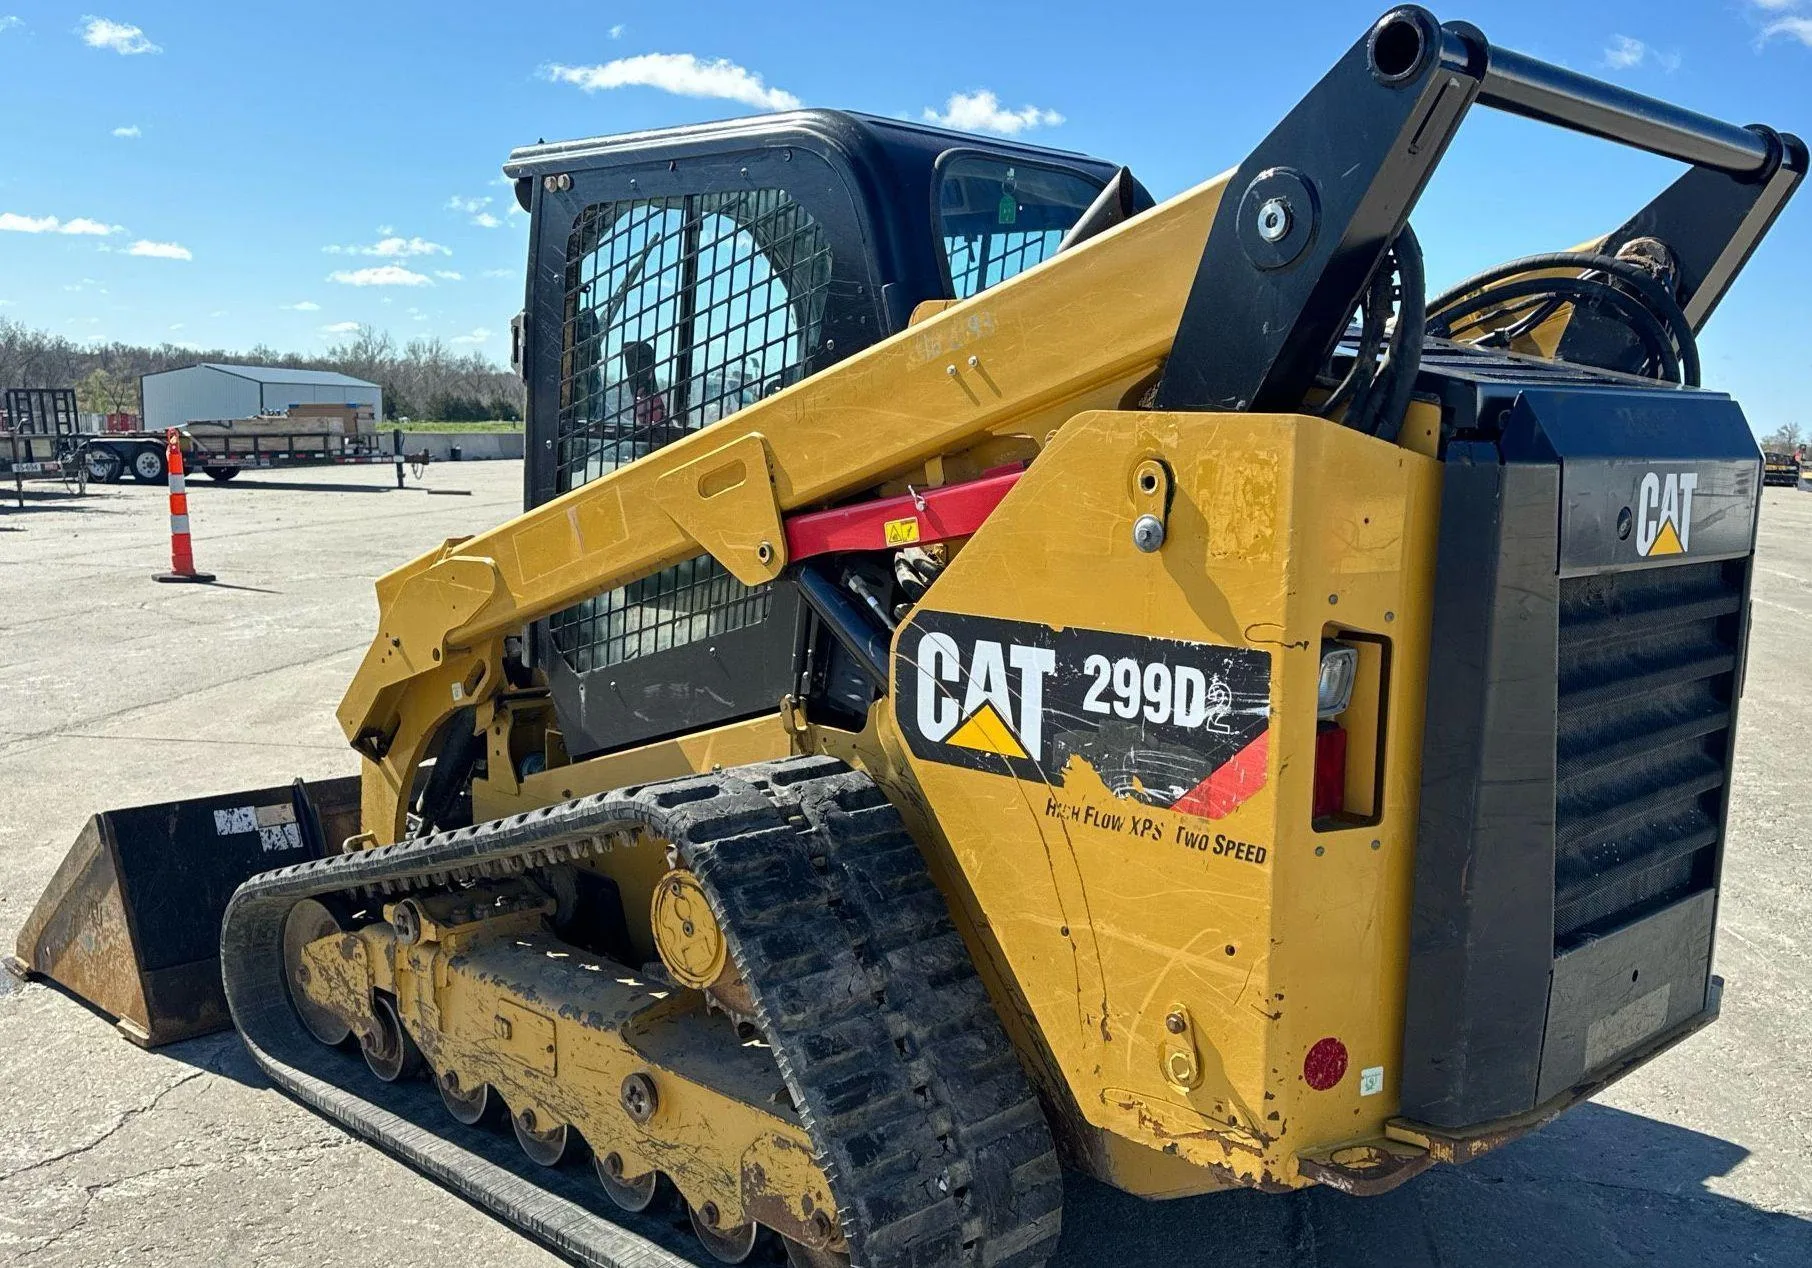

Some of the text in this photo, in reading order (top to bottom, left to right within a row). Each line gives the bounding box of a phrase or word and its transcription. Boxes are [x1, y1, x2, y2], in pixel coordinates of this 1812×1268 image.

[1636, 472, 1698, 556] CAT
[917, 632, 1056, 762] CAT
[1045, 797, 1268, 864] HH FLOW XPS TWO SPEED
